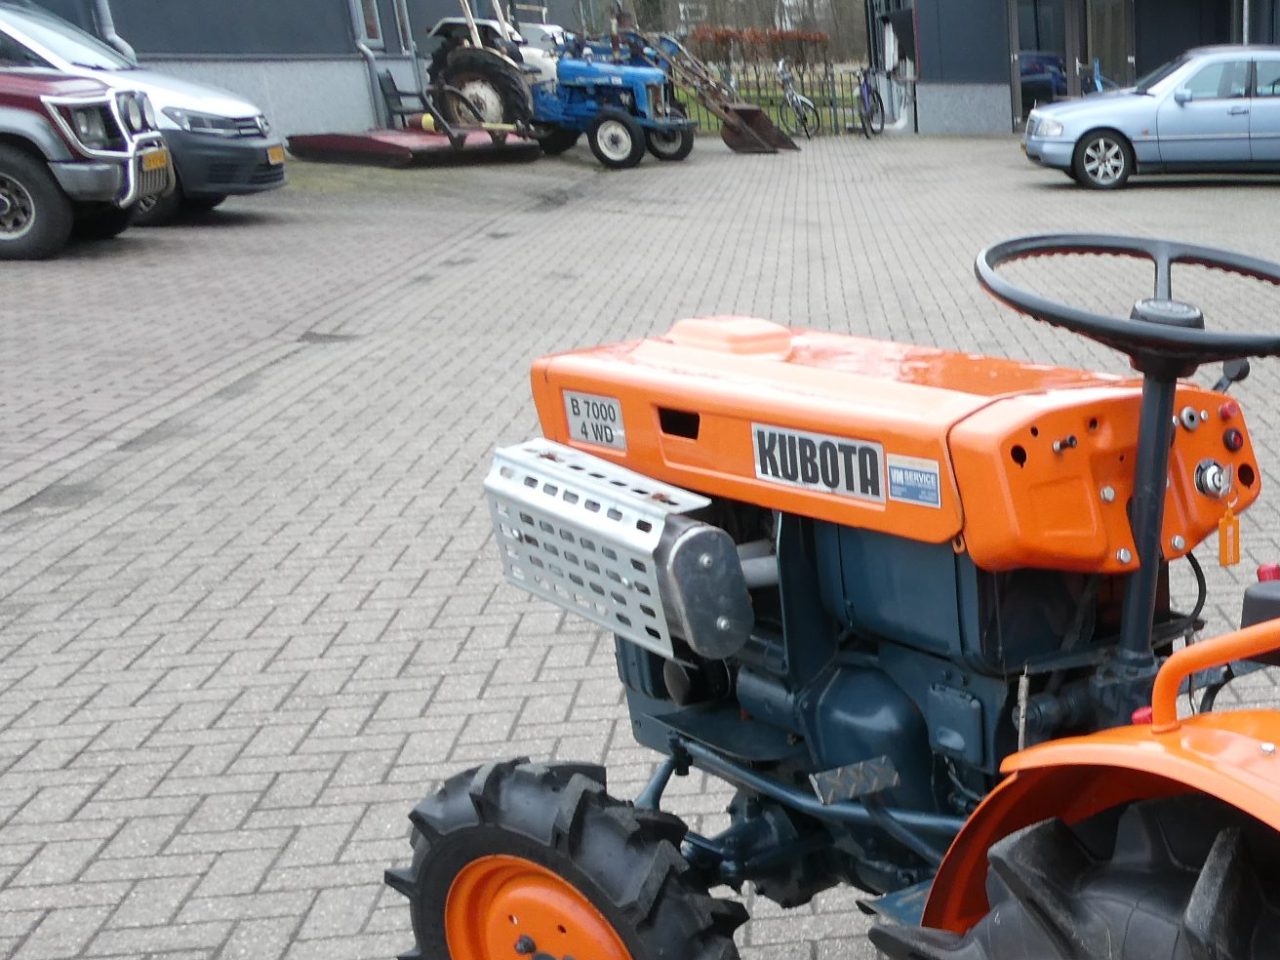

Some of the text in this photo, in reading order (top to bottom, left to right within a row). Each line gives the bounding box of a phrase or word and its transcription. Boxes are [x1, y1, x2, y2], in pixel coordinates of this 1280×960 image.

[571, 398, 616, 422] B 7000
[580, 421, 614, 443] 4 WD
[757, 430, 880, 497] KUBOTA
[904, 469, 936, 487] SERVICE
